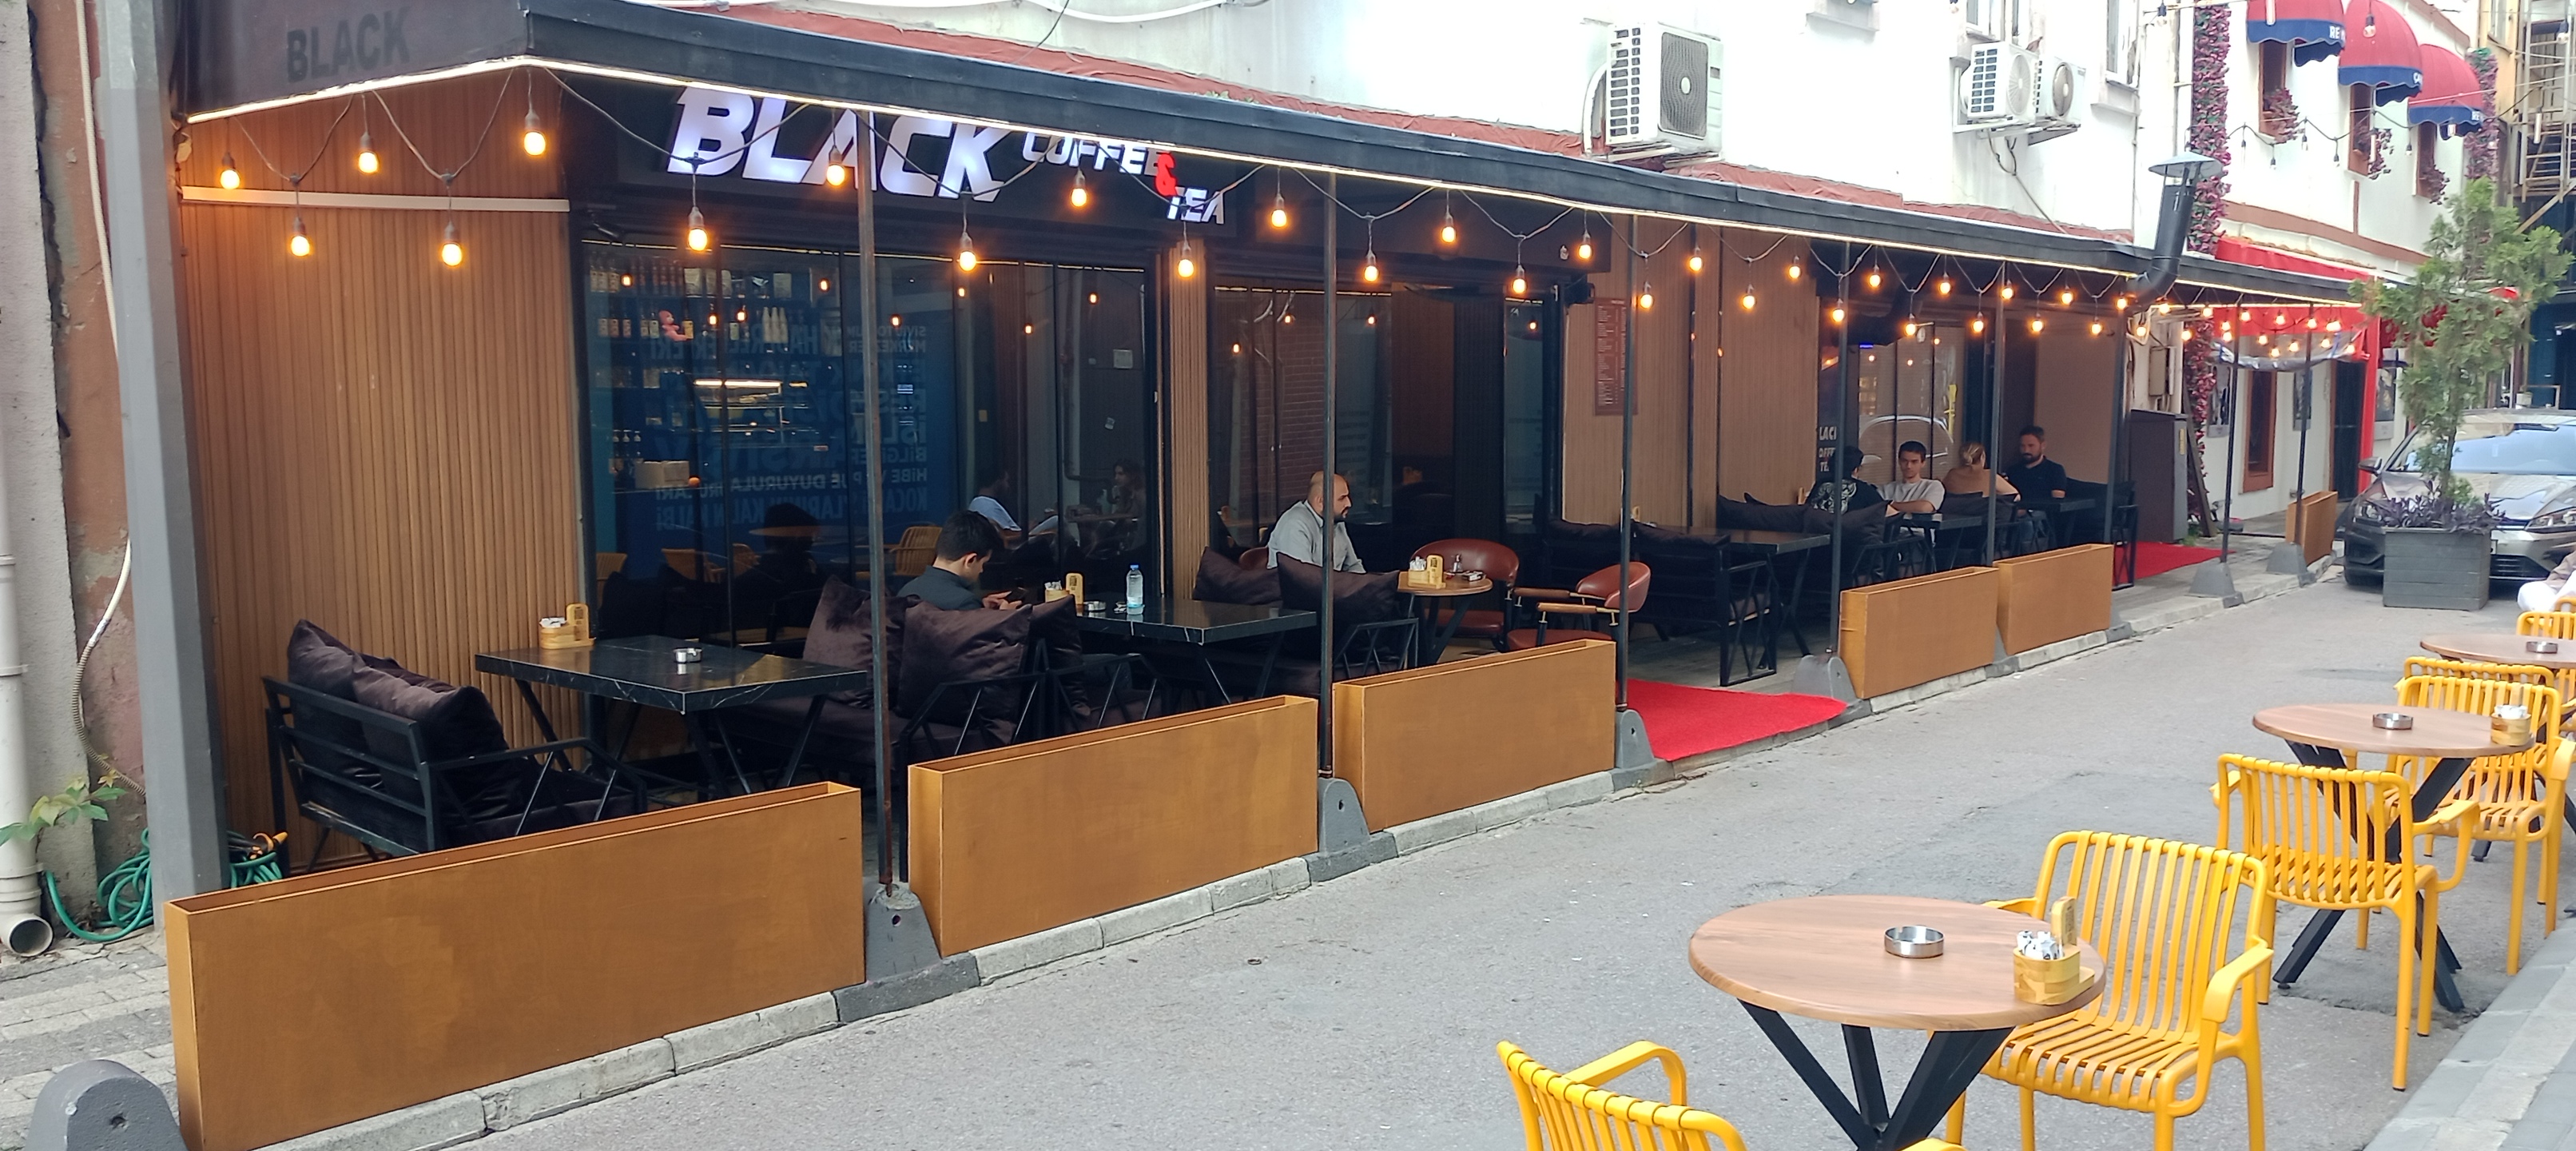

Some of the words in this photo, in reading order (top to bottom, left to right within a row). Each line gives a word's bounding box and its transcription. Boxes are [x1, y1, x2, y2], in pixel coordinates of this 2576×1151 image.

[287, 6, 411, 83] BLACK
[667, 86, 1012, 202] BLACK
[1167, 186, 1225, 224] TEA
